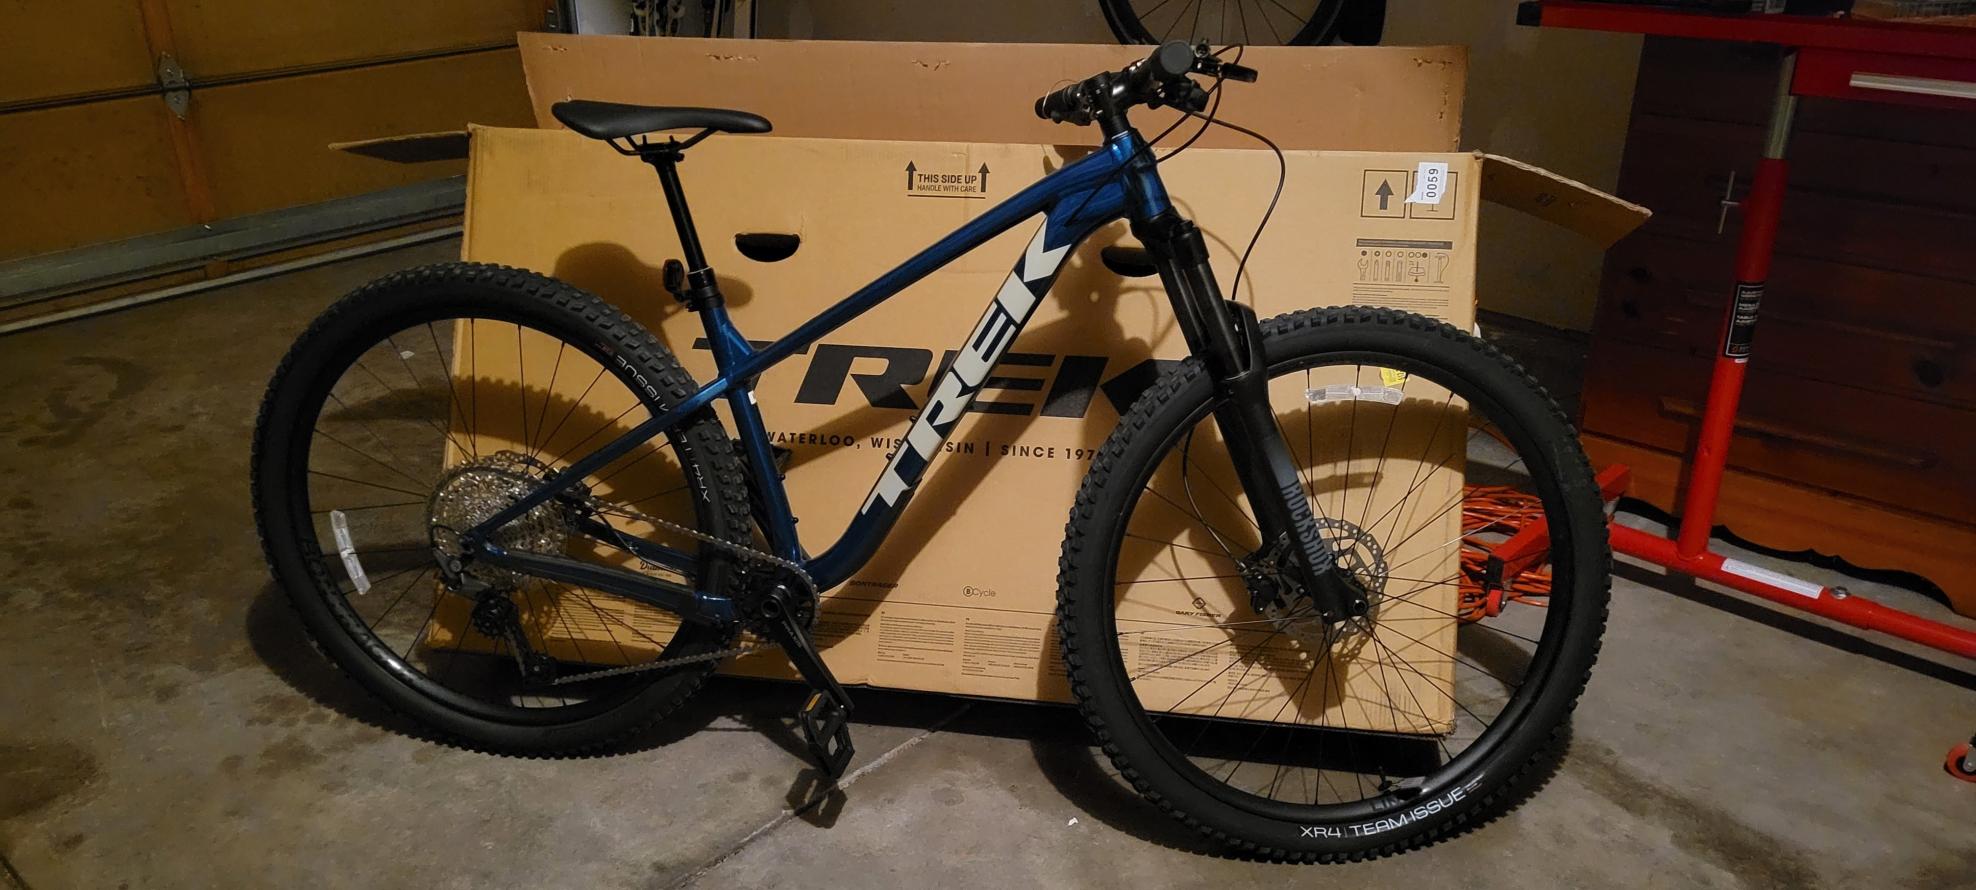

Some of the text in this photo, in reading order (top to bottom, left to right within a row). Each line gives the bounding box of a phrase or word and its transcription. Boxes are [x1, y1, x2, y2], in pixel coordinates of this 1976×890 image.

[917, 173, 977, 185] THIS SIDE UP
[917, 184, 977, 193] HANDLE WITH CARE
[1425, 167, 1439, 199] 0059
[616, 354, 662, 404] ISSUE
[860, 211, 1072, 516] TREK
[870, 437, 974, 454] WISSIN
[1000, 444, 1055, 459] SINCE
[1065, 448, 1099, 460] 197
[1300, 785, 1467, 839] XR4 TEAM ISSUE
